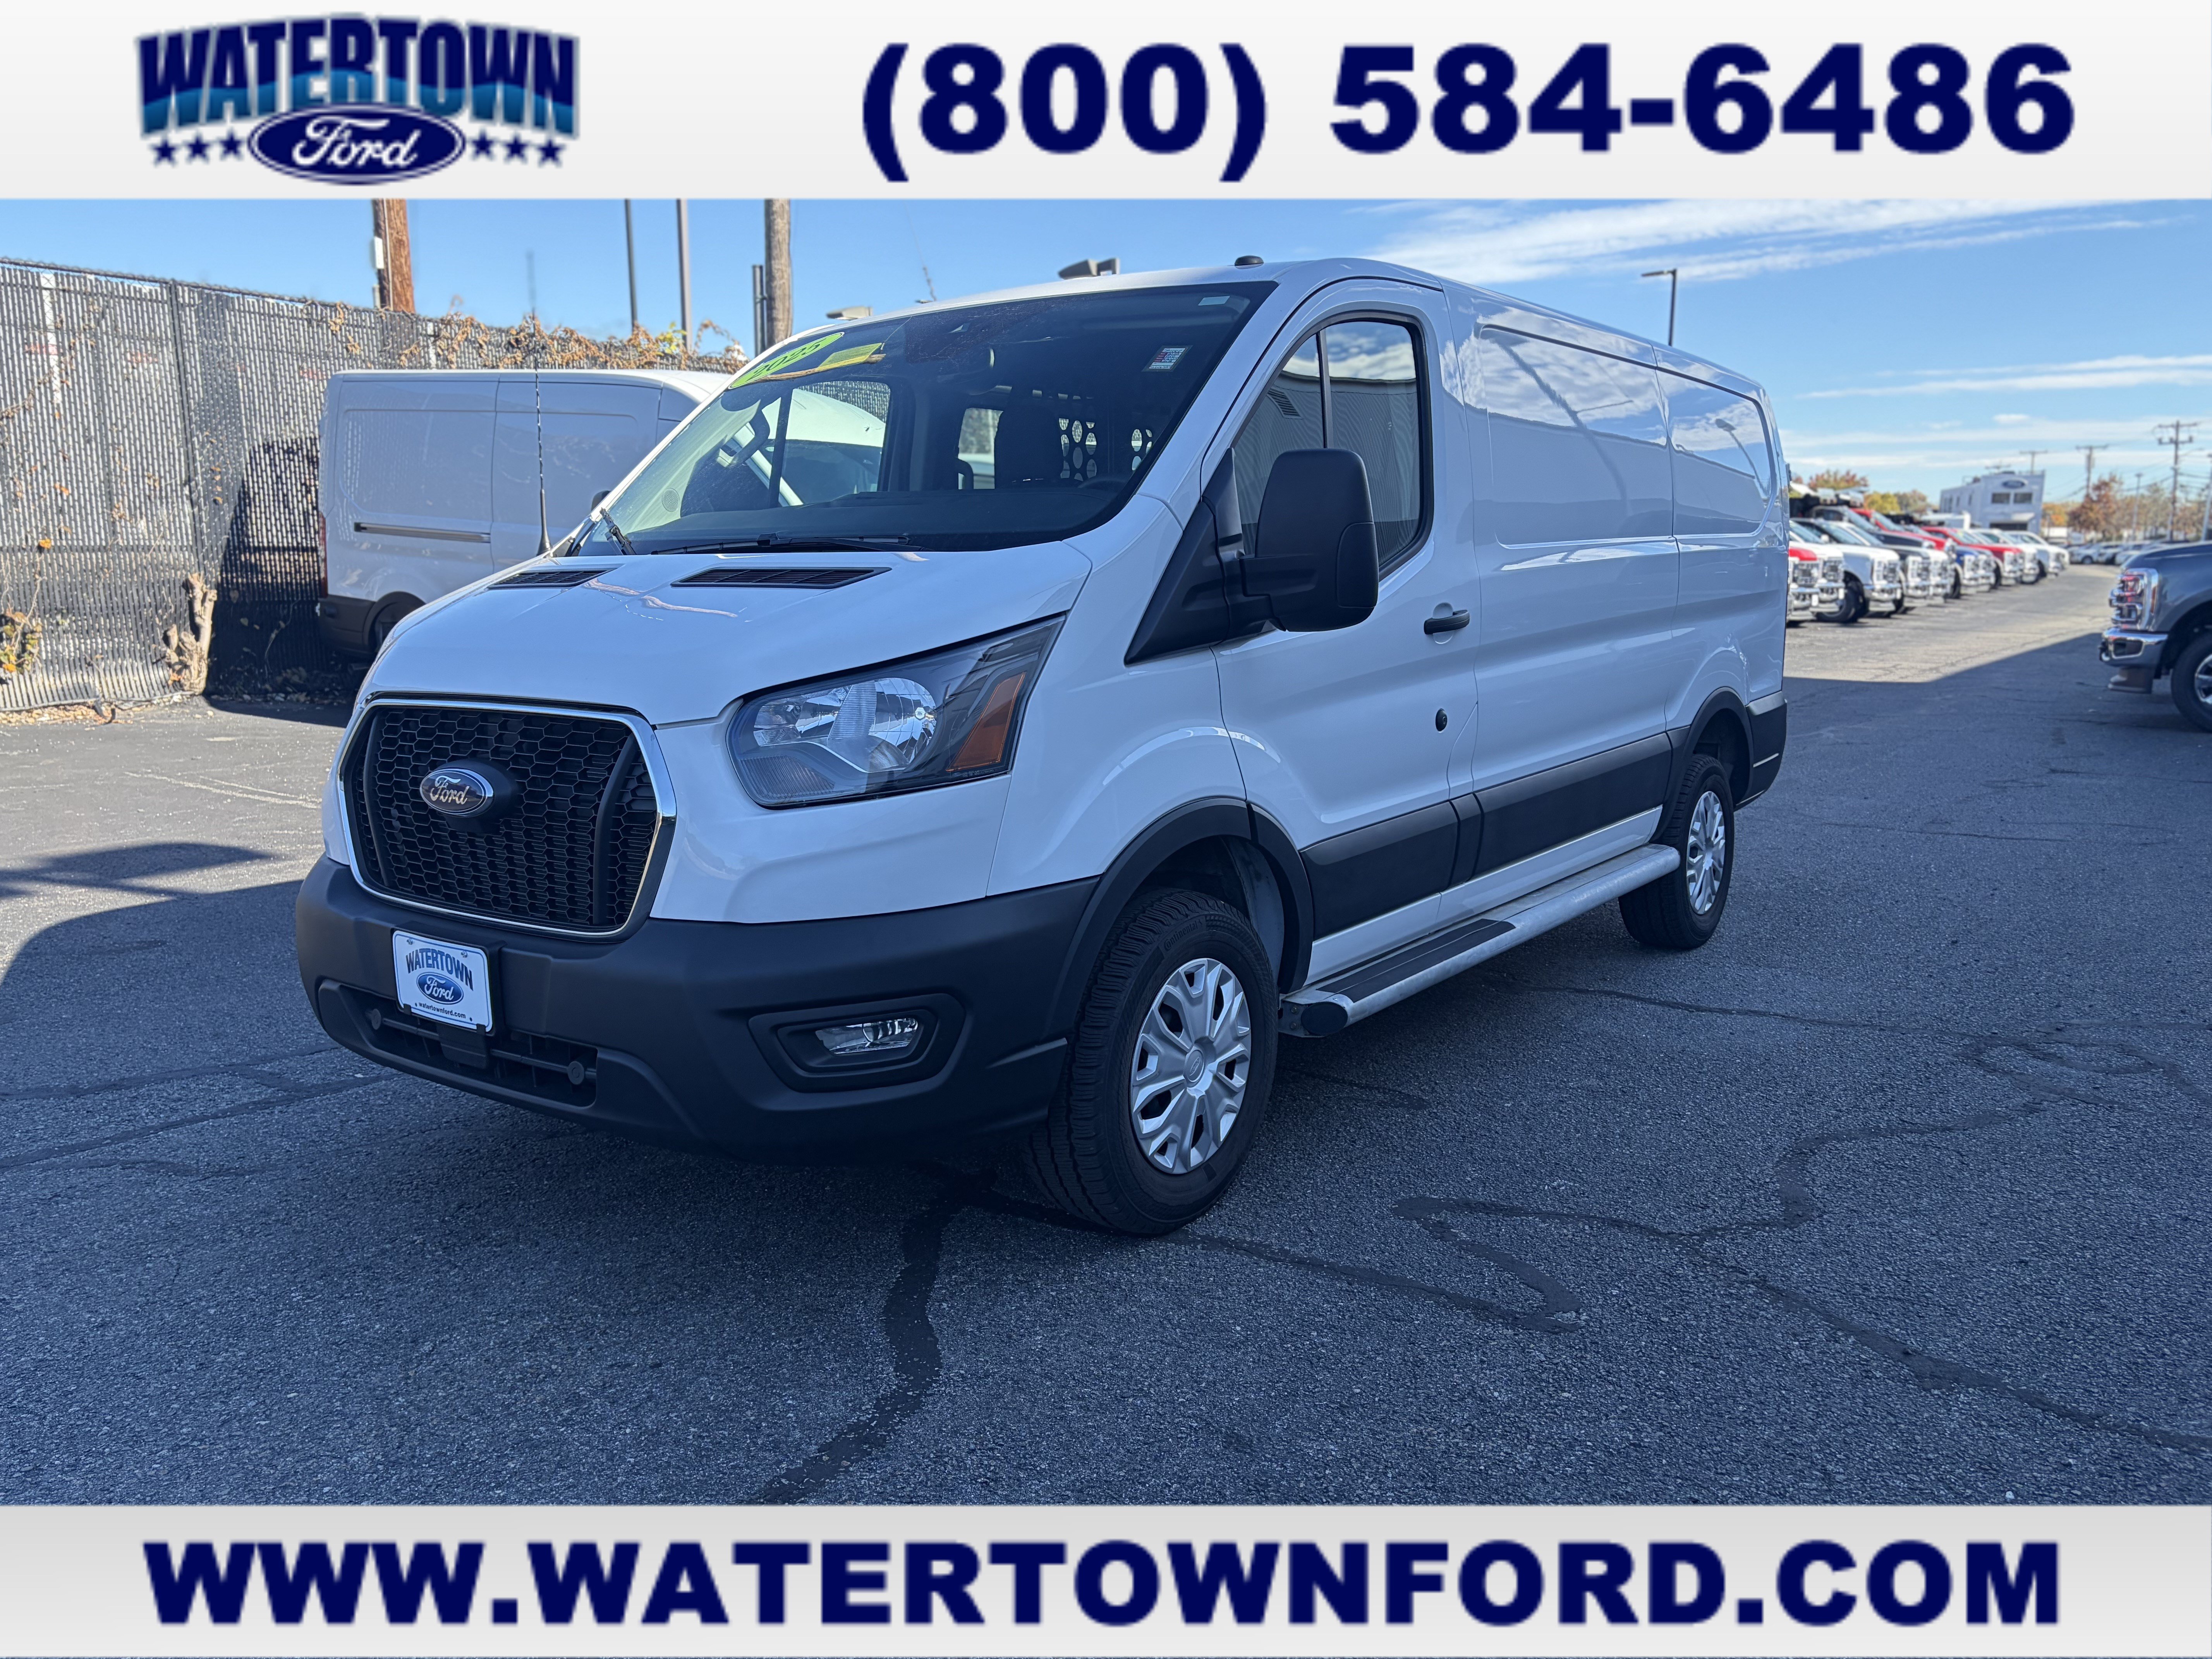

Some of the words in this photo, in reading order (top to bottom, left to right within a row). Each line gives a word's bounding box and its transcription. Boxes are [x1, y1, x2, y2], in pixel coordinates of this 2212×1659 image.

[745, 338, 827, 383] 2025
[429, 775, 470, 805] Ford
[1164, 920, 1198, 951] Continental
[405, 948, 474, 992] WATERTOWN
[424, 975, 454, 1001] Ford
[418, 1002, 466, 1019] watertownford.com
